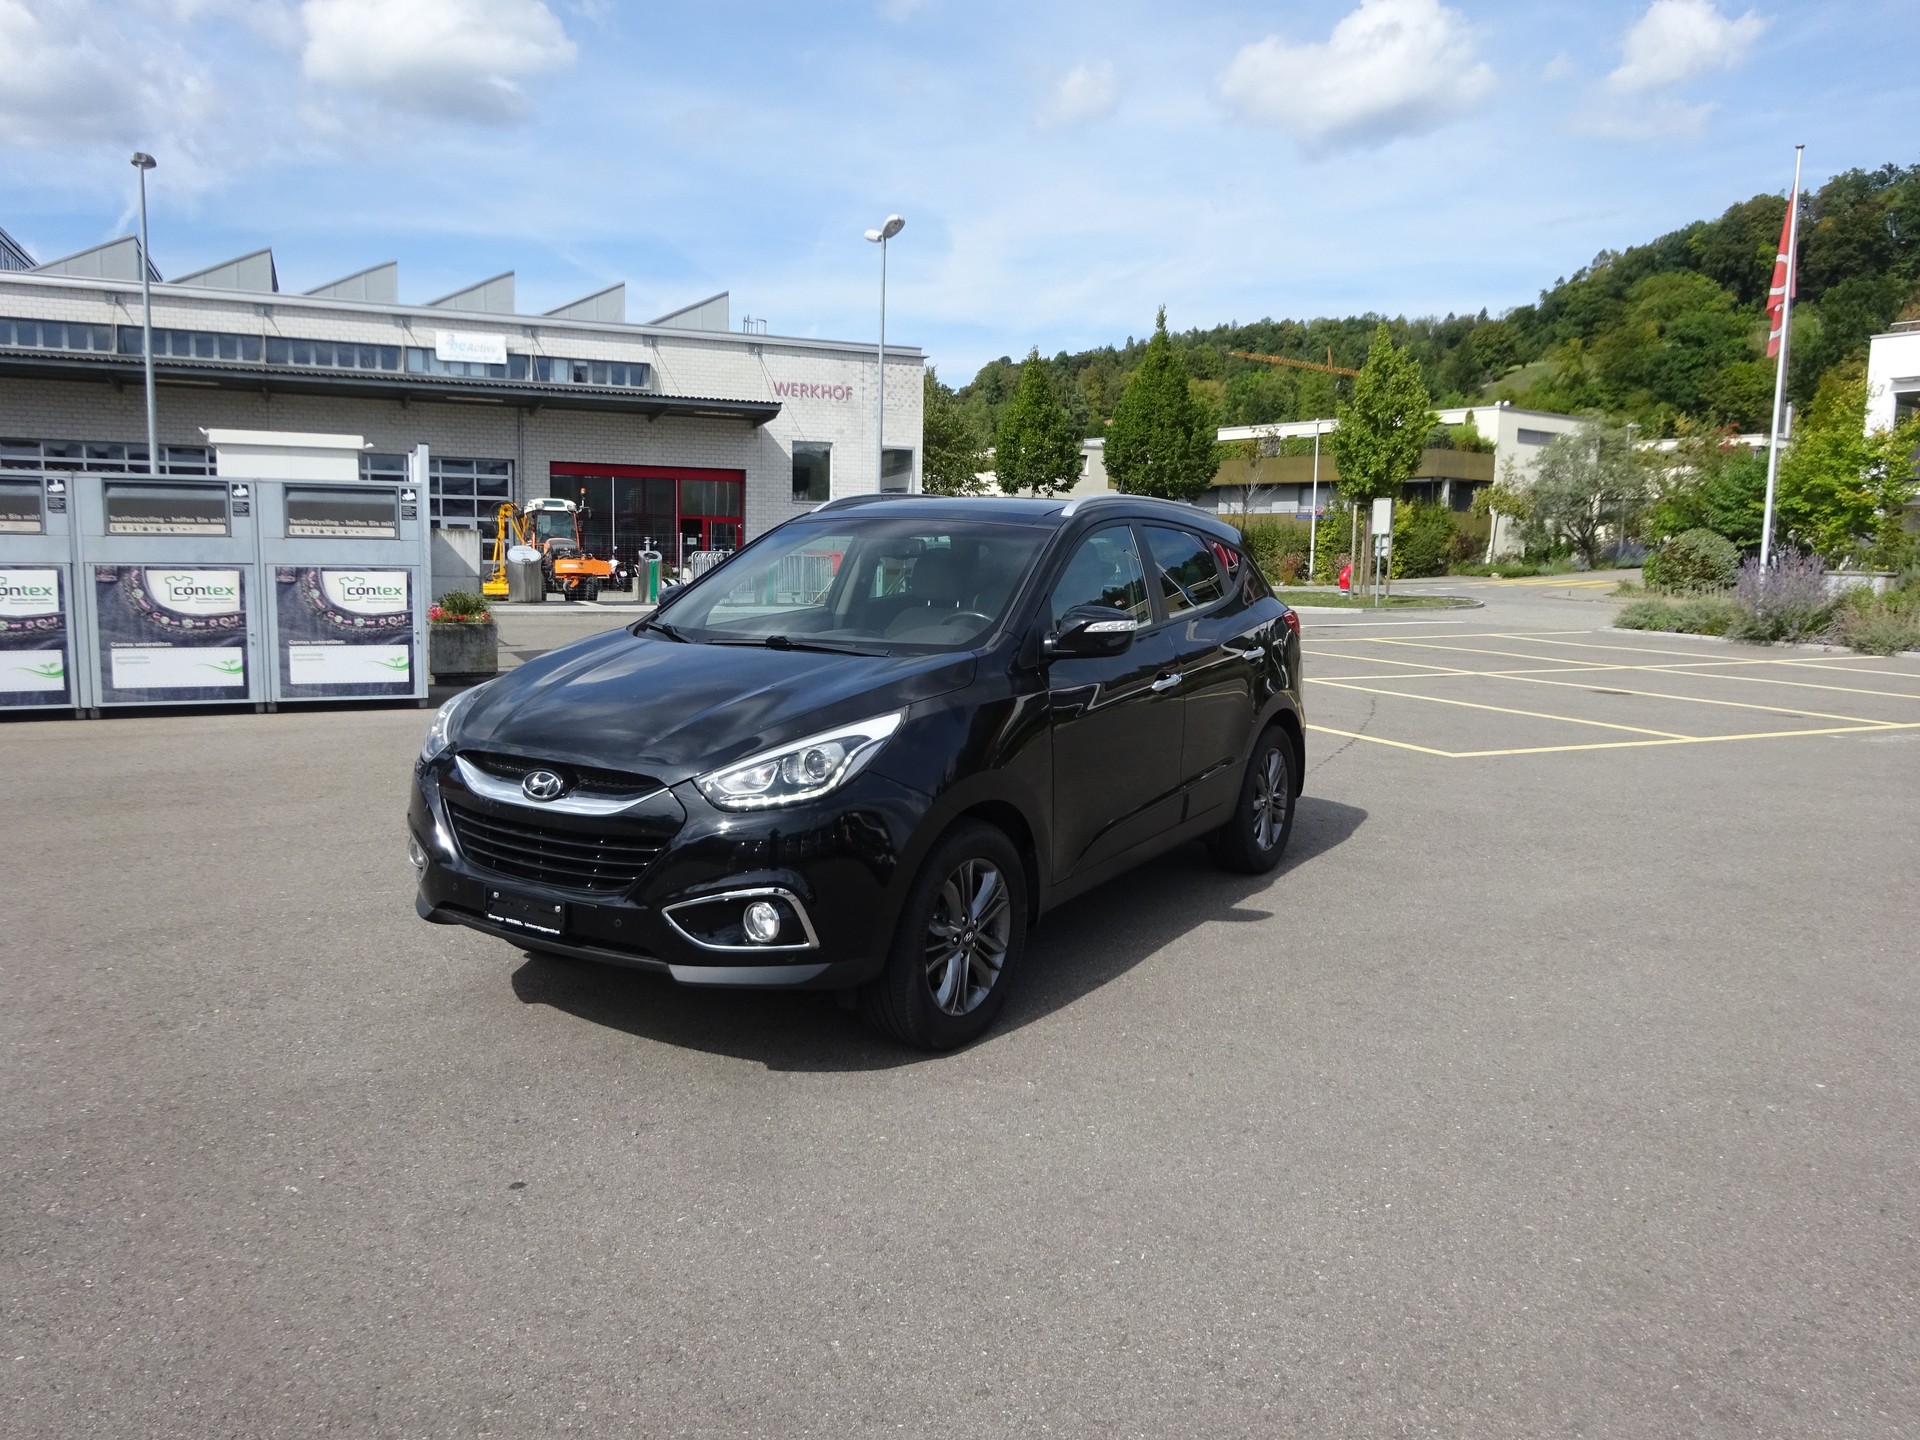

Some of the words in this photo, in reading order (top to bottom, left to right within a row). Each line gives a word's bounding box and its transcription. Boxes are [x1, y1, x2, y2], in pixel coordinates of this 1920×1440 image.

[773, 381, 854, 401] WERKHOF
[289, 518, 340, 526] Textilrecycling
[0, 585, 53, 596] ontex
[173, 585, 235, 596] contex
[346, 585, 403, 596] contex
